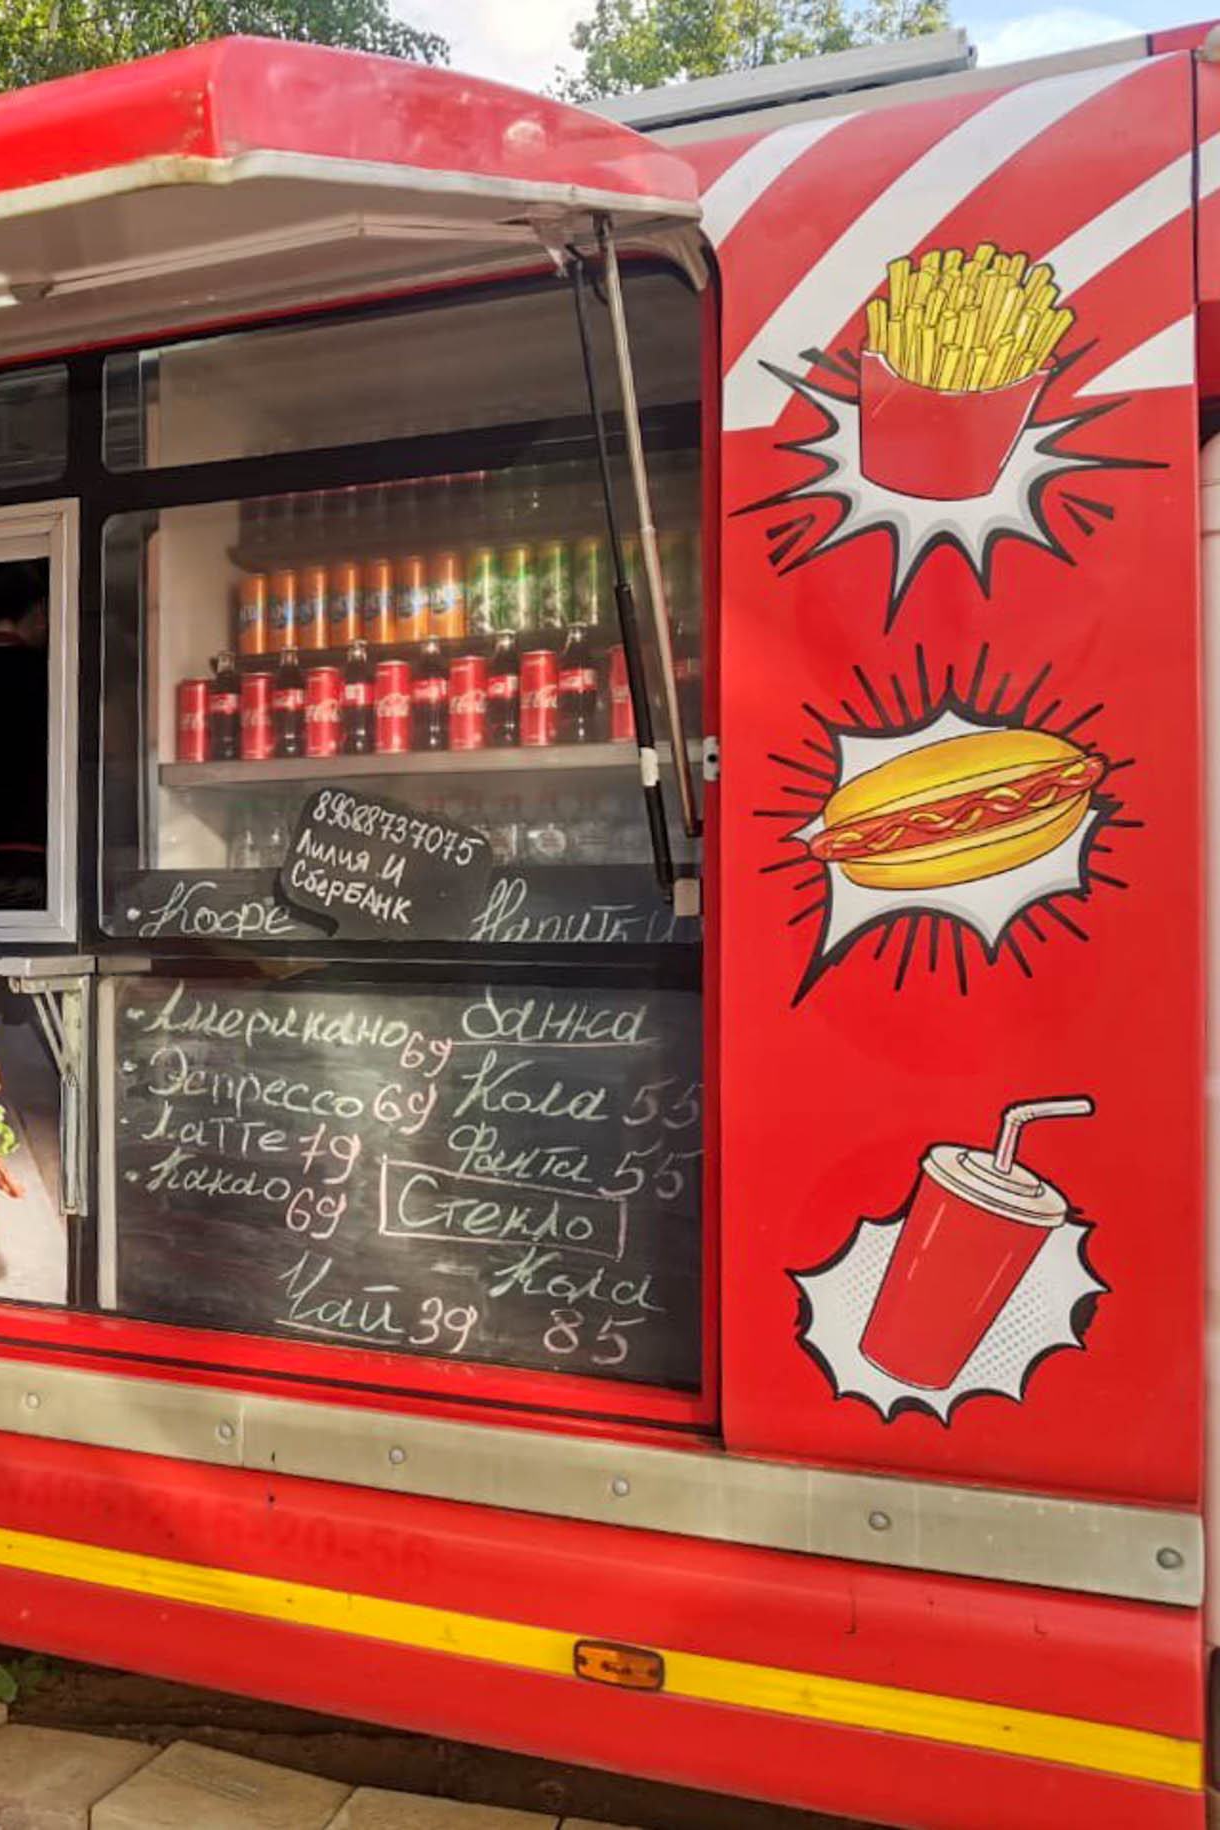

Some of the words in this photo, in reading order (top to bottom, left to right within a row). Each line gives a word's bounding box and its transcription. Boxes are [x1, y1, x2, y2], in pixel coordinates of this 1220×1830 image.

[312, 790, 485, 866] 89688737075
[142, 980, 408, 1047] Американо
[400, 1031, 453, 1077] 69
[148, 1048, 363, 1117] Эспрессо
[374, 1083, 438, 1134] 69
[452, 1049, 608, 1120] Кола
[142, 1100, 288, 1158] Латте
[146, 1147, 292, 1200] Какао
[286, 1187, 347, 1239] 69
[398, 1174, 595, 1242] Стекло
[279, 1250, 404, 1334] Чай
[409, 1297, 478, 1354] 39
[489, 1247, 666, 1312] Кола
[543, 1310, 649, 1365] 85
